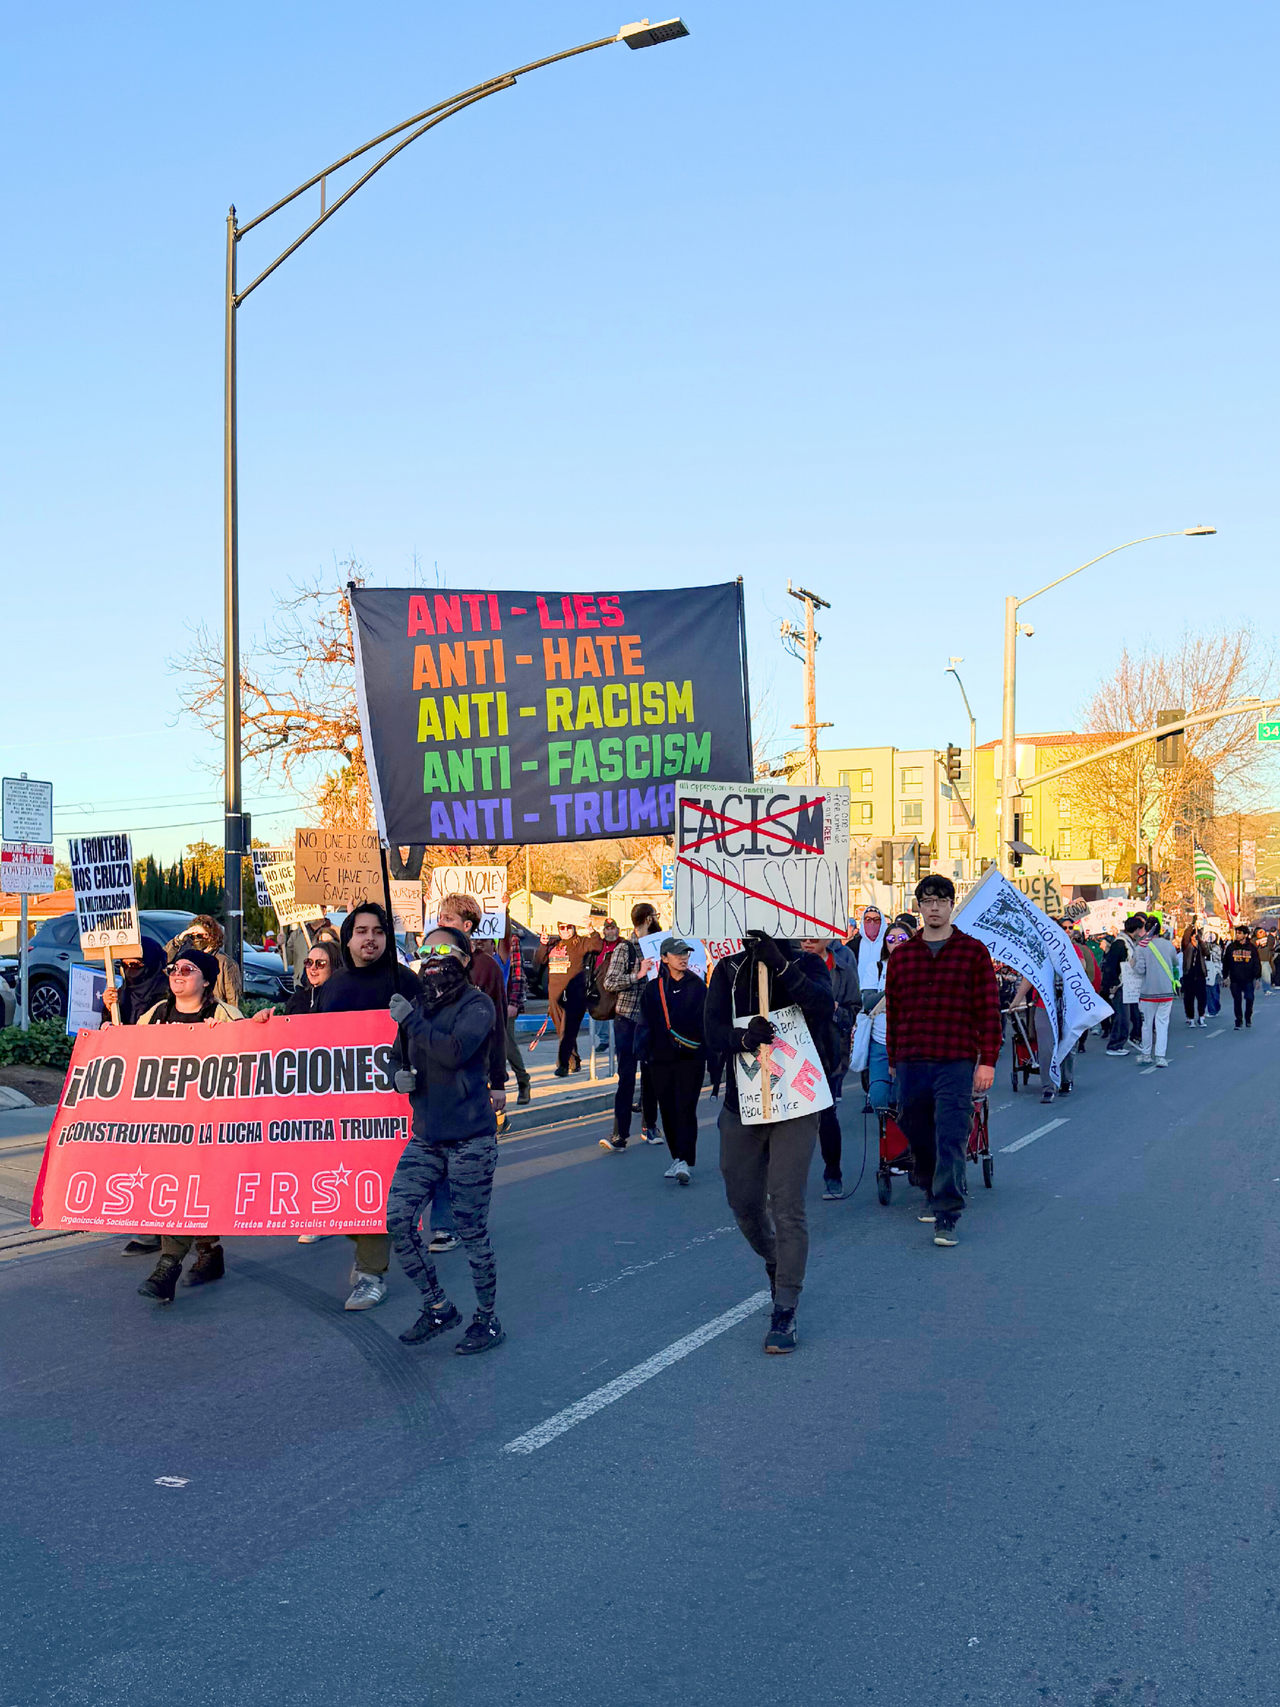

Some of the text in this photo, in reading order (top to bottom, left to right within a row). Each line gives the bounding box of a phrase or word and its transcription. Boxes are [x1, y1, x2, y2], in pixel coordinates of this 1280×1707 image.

[407, 594, 501, 637] ANTI
[536, 595, 625, 630] LIES
[412, 639, 506, 691] ANTI
[542, 635, 645, 680] HATE
[417, 691, 509, 743] ANTI
[545, 680, 695, 733] RACISM
[423, 745, 511, 794] ANTI
[548, 731, 712, 786] FASCISM
[690, 783, 726, 792] oppression
[738, 785, 774, 794] connected
[430, 798, 514, 840] ANTI
[550, 784, 675, 837] TRUMP
[679, 794, 825, 857] FACISM
[298, 832, 379, 849] NO ONE IS COM
[69, 834, 129, 866] LA FRONTERA
[314, 851, 327, 864] TO
[333, 851, 352, 863] SAVE
[2, 865, 53, 876] TOWED AWAY
[72, 866, 92, 892] NOS
[93, 863, 132, 890] CRUZO
[265, 870, 278, 882] NO
[279, 866, 293, 880] ICE
[303, 866, 330, 882] WE
[338, 868, 362, 884] HAVE
[366, 870, 380, 884] TO
[270, 882, 287, 896] SAN
[434, 868, 505, 896] NO MONEY
[324, 883, 368, 901] SAVE US
[676, 857, 850, 937] OPPRESSION
[1067, 900, 1087, 918] GOOD
[80, 911, 133, 932] EN LA FRONTERA
[392, 914, 421, 928] EXT?
[709, 938, 743, 959] GESTA
[998, 947, 1021, 965] las
[1066, 972, 1096, 1012] Todos
[774, 1007, 796, 1019] TIME
[62, 1044, 395, 1109] ¡NO DEPORTACIONES
[740, 1093, 760, 1103] TIME
[742, 1102, 798, 1118] ABOLH ICE
[57, 1116, 409, 1147] ¡CONSTRUYENDO LA LUCHA CONTRA TRUMP!
[61, 1215, 104, 1225] Organización
[106, 1218, 139, 1227] Socialista
[140, 1220, 165, 1228] Camino
[233, 1219, 382, 1229] Freedom Road Socialist Organization
